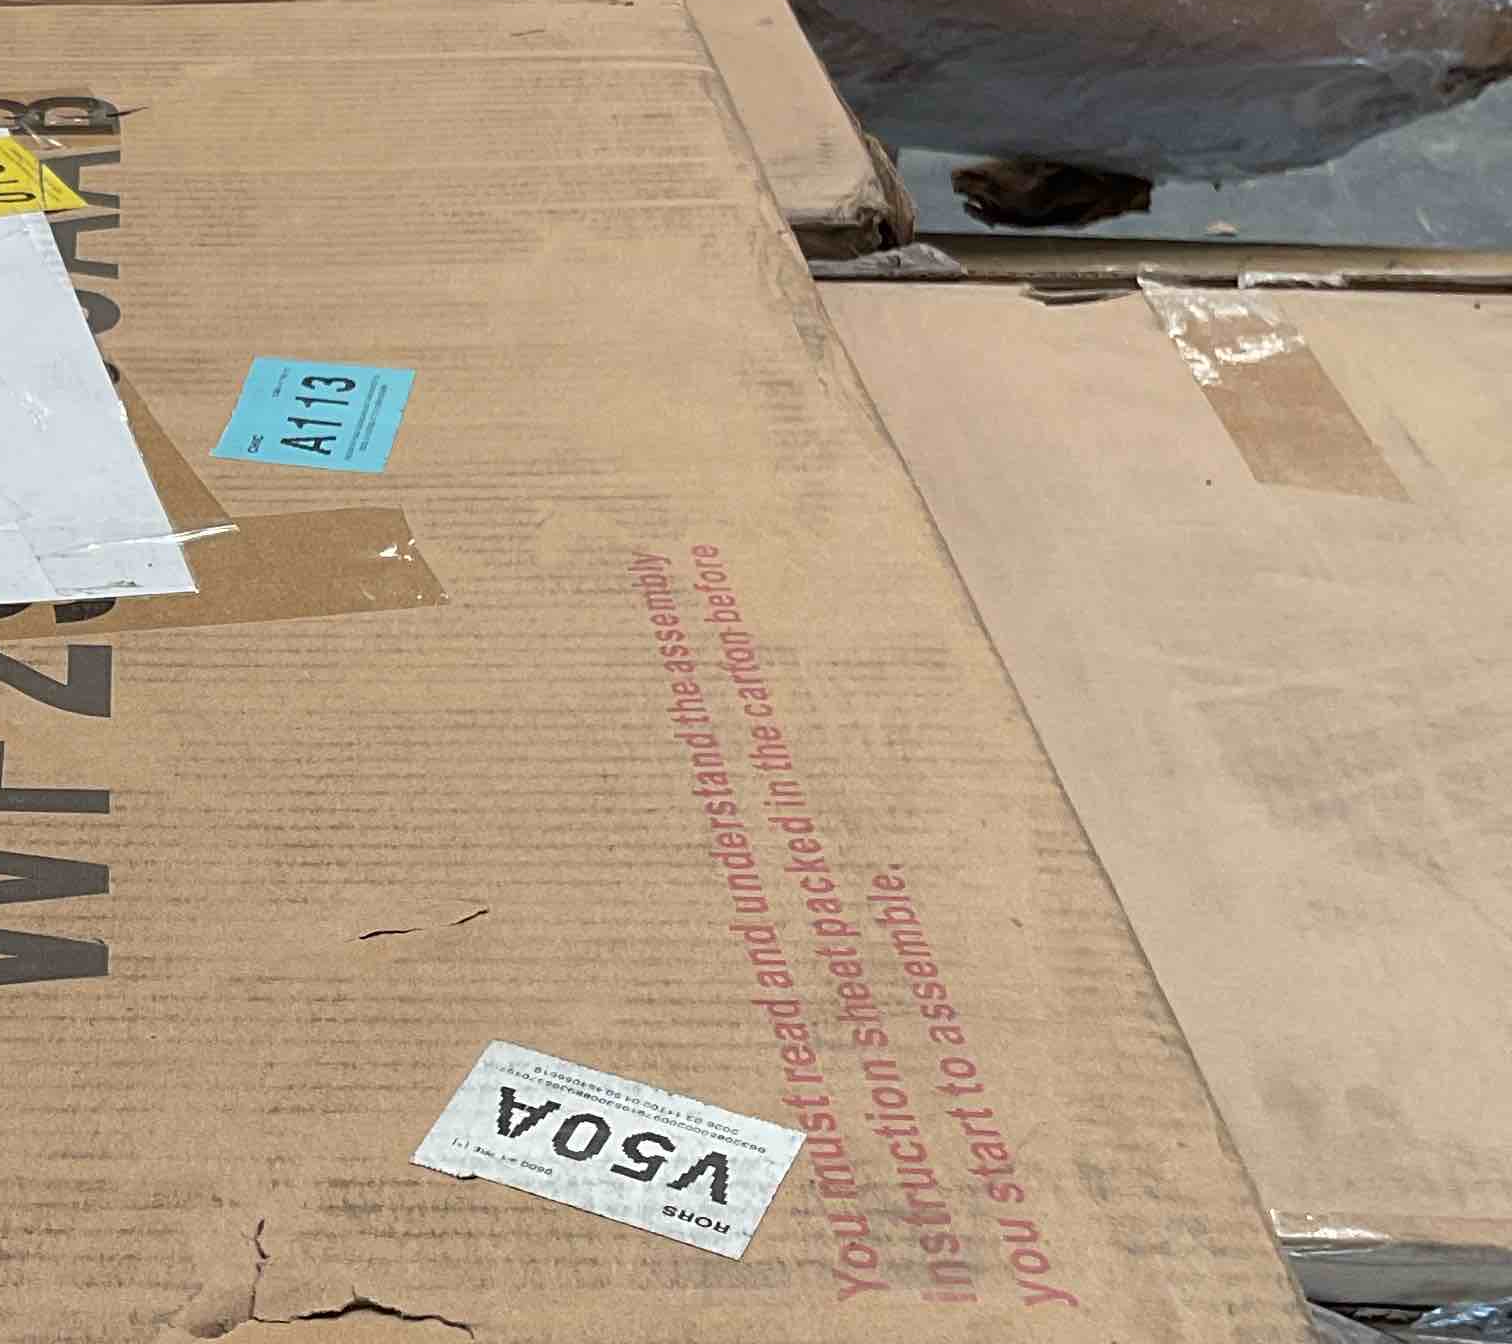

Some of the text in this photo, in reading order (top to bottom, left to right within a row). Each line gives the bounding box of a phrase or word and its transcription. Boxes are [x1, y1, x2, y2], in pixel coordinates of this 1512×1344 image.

[279, 373, 357, 456] A113
[628, 552, 888, 1302] You must read and understand the assembly
[690, 544, 978, 1303] instruction sheet packed in the carton before
[494, 1086, 729, 1205] V50A
[662, 1205, 730, 1234] RORS
[866, 862, 1079, 1306] you start to assemble.
